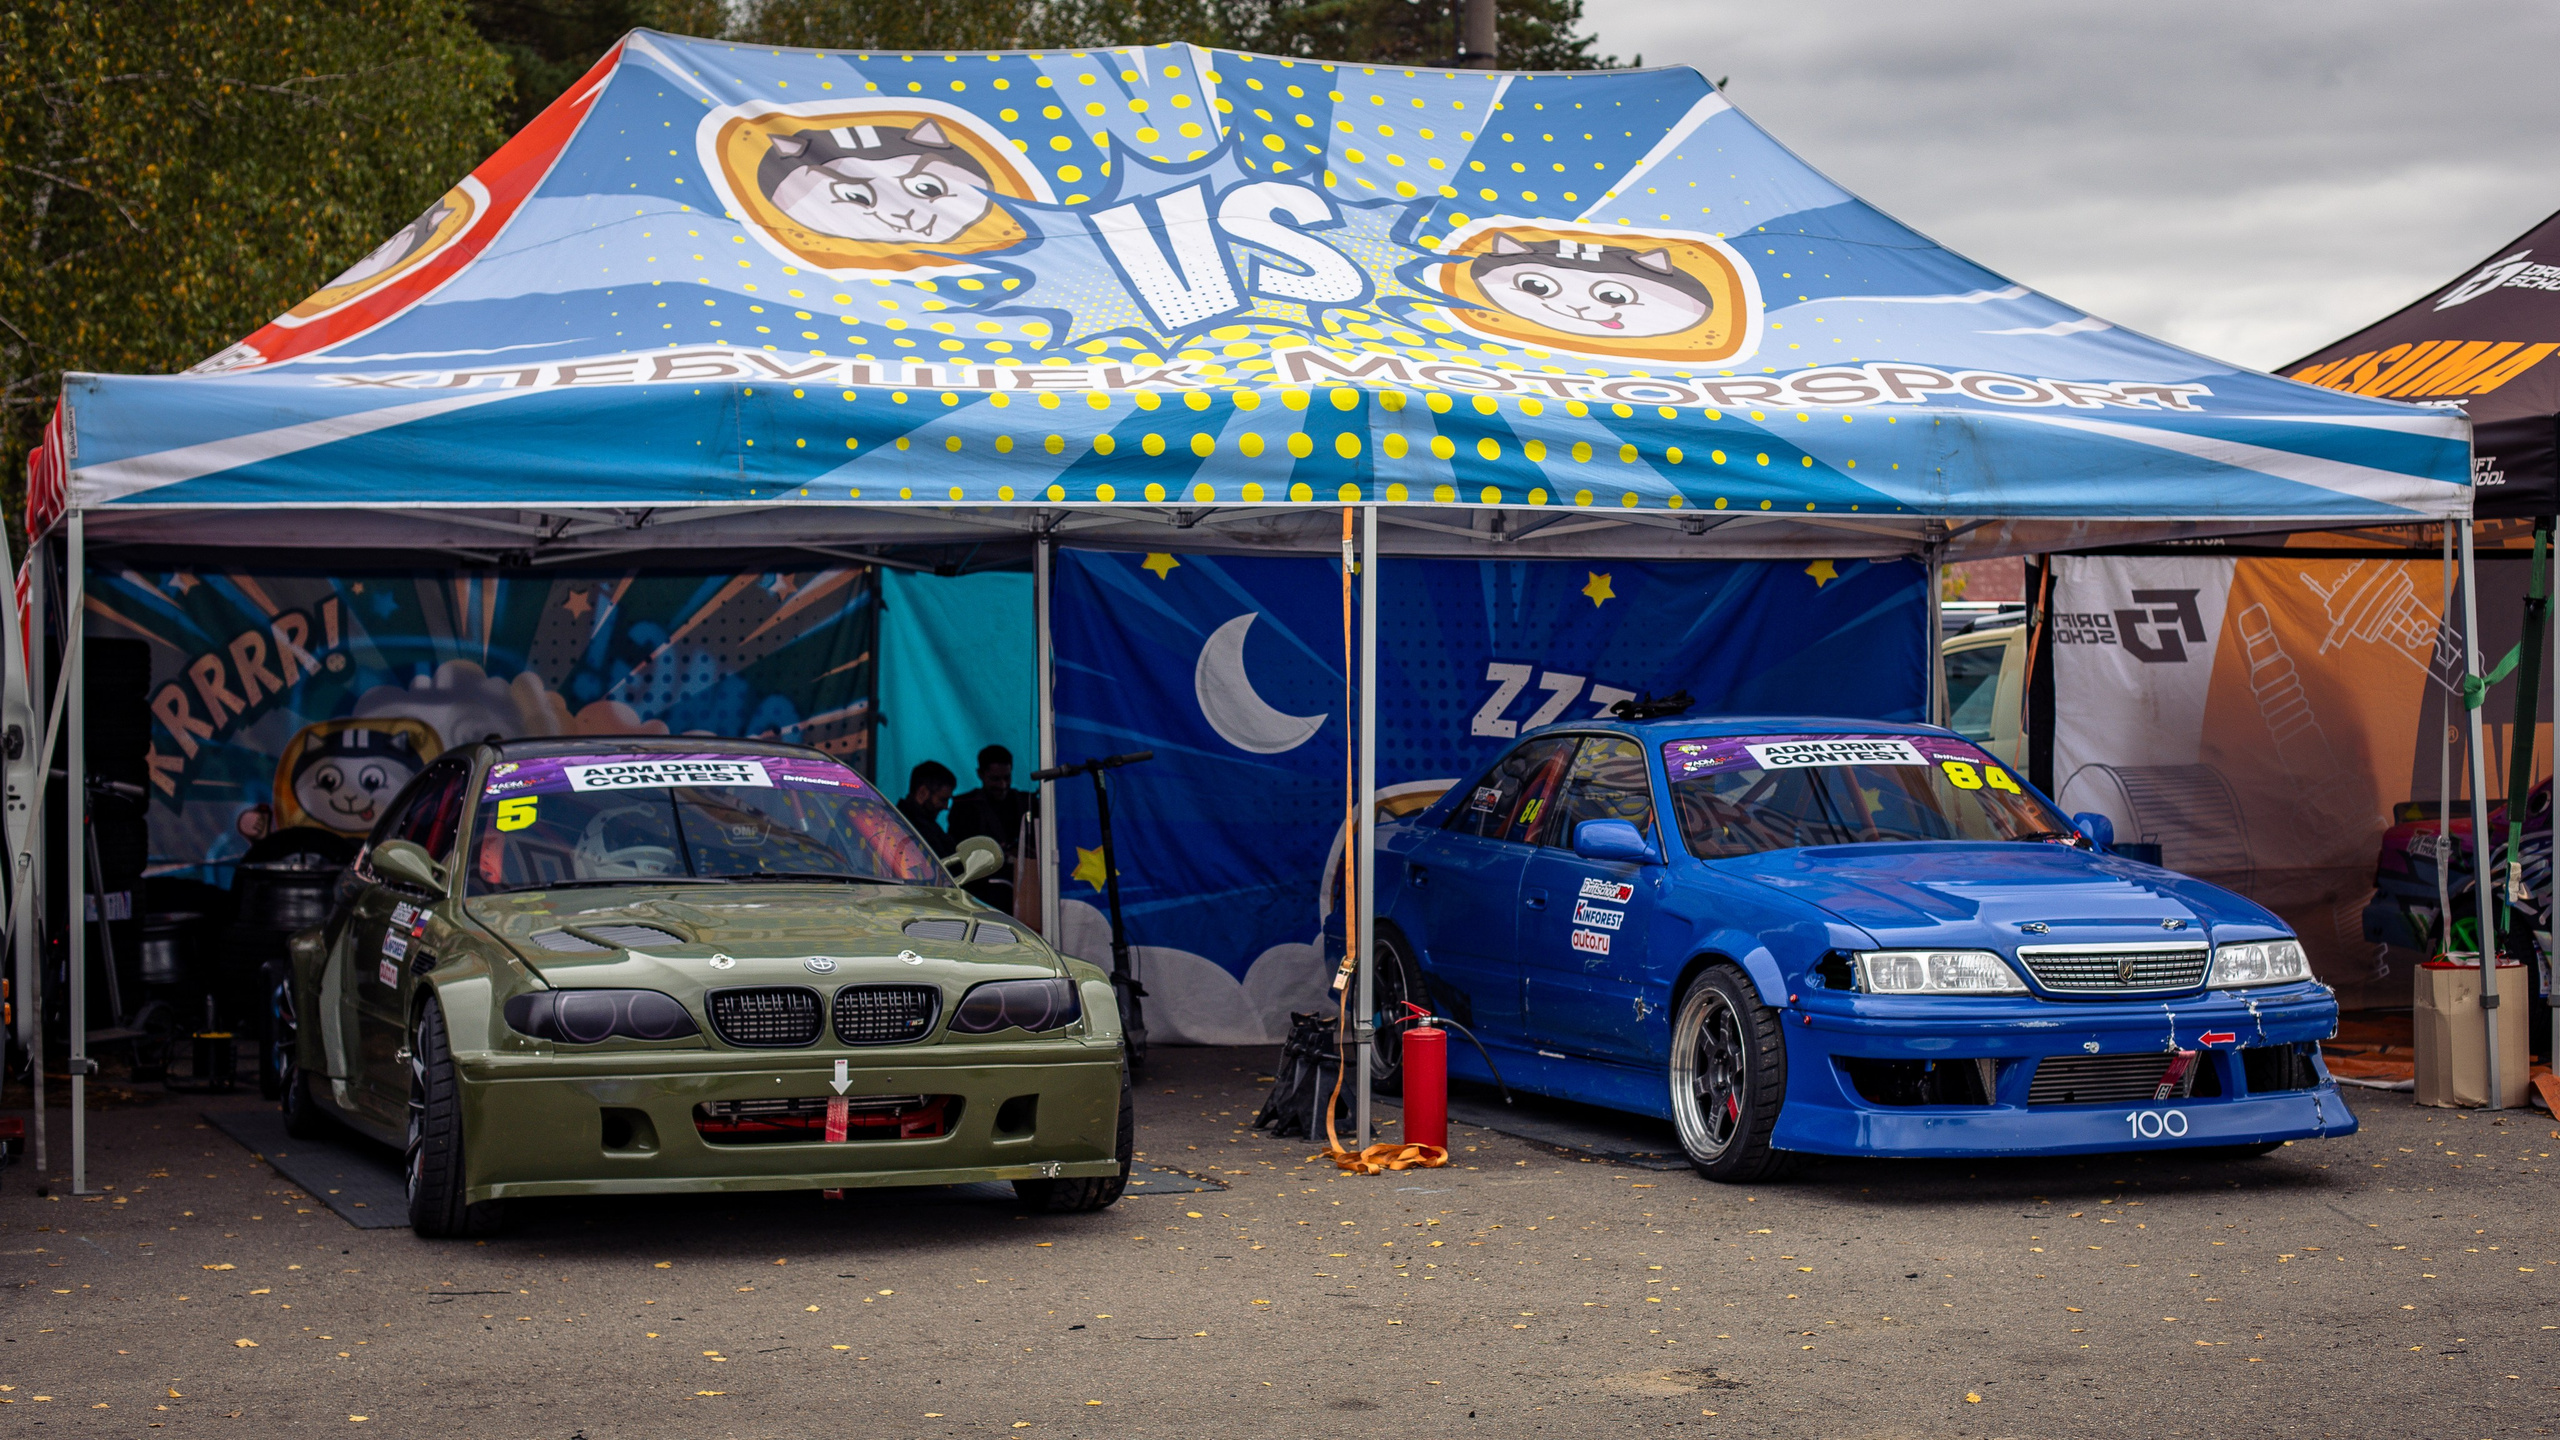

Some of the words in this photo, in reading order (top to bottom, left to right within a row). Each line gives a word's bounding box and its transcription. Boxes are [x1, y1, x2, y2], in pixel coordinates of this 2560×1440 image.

[1089, 181, 1363, 331] VS
[328, 348, 1202, 390] ХЛЕБУШЕК
[1284, 350, 2202, 410] MOTORSPORT
[1471, 662, 1637, 739] ZZZ
[1765, 744, 1825, 756] ADM
[1827, 742, 1901, 752] DRIFT
[1769, 751, 1910, 765] CONTEST
[583, 764, 655, 777] ADM
[660, 763, 749, 773] DRIFT
[585, 773, 754, 787] CONTEST
[1941, 761, 2021, 795] 84
[496, 795, 538, 832] 5
[1520, 798, 1544, 824] 84
[732, 826, 759, 836] OMP
[1575, 901, 1623, 927] KINFOREST
[1573, 932, 1609, 952] auto.ru
[2126, 1109, 2188, 1139] 100
